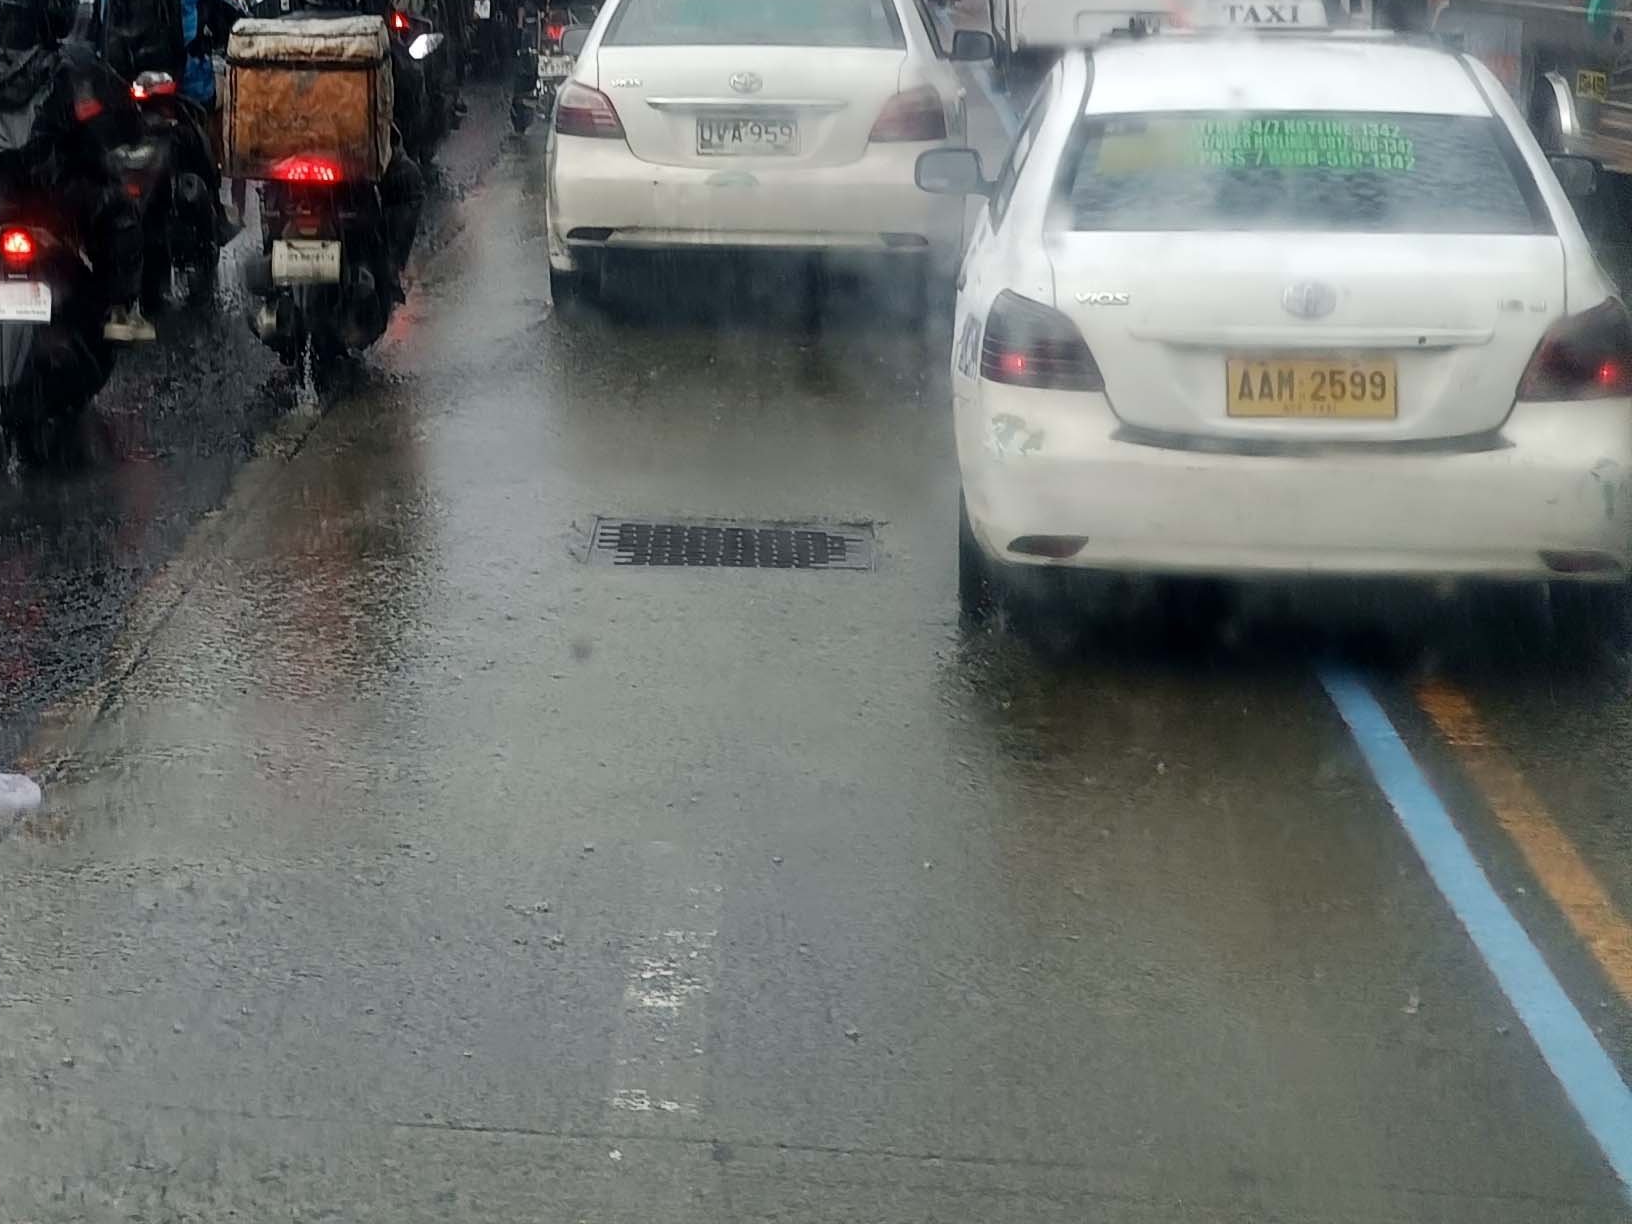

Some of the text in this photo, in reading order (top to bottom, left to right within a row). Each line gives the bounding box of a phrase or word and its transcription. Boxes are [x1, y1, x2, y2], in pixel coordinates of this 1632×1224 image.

[1223, 4, 1301, 24] TAXI
[749, 122, 794, 145] 959
[1074, 290, 1130, 306] VIOS
[1238, 368, 1387, 403] AAM 2599
